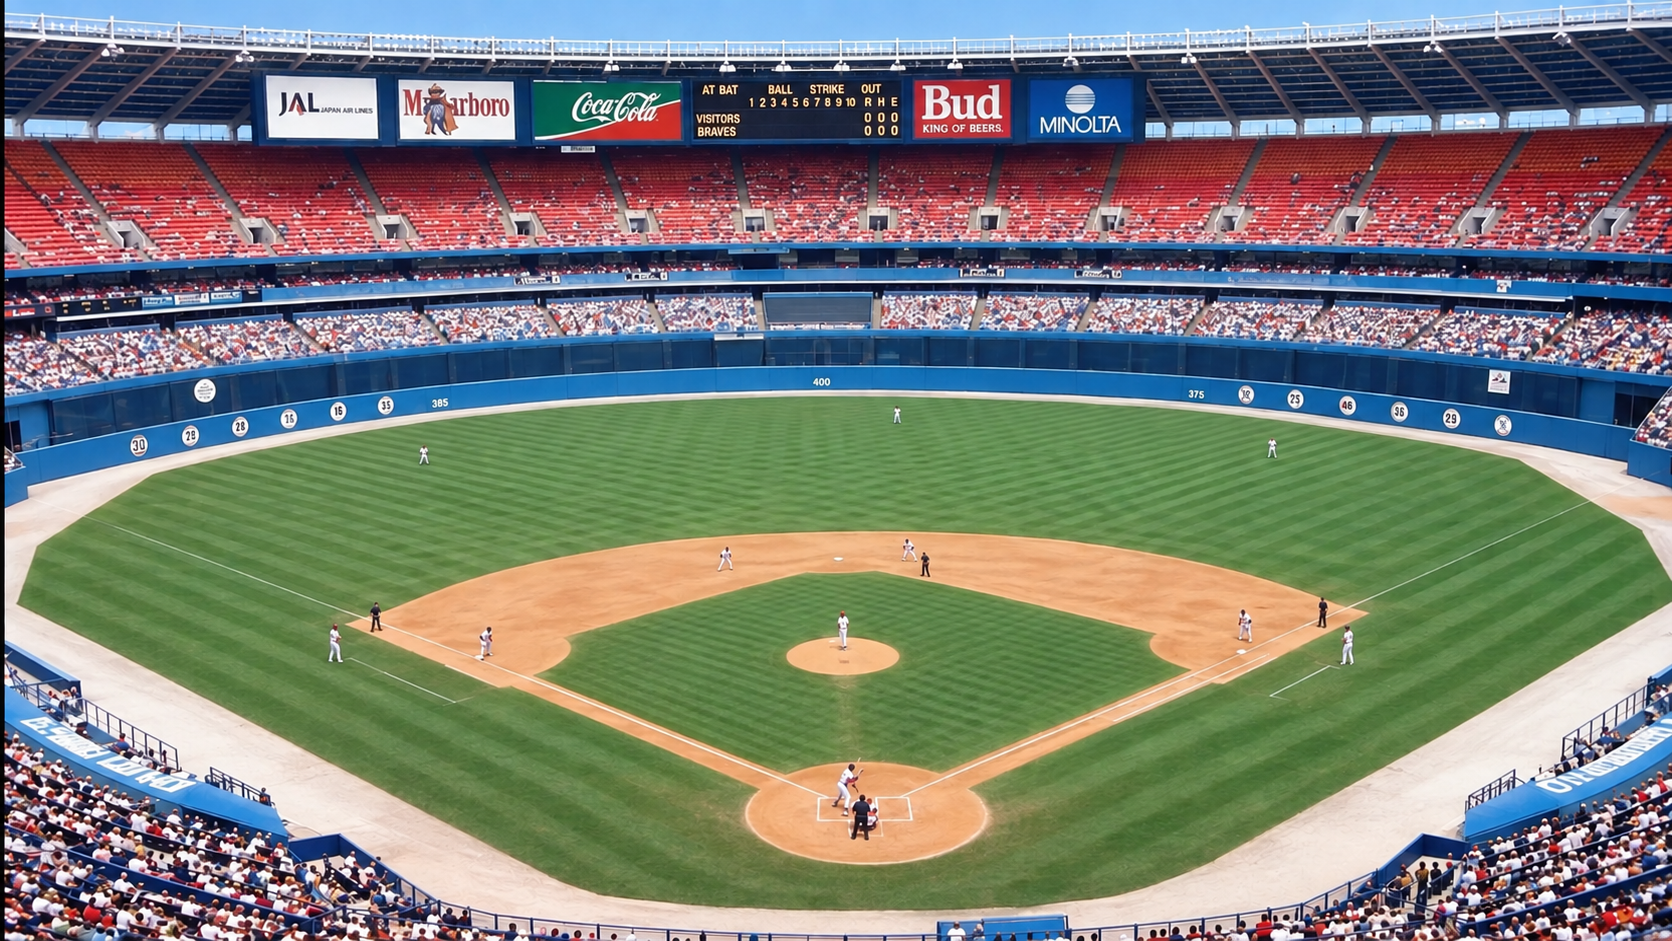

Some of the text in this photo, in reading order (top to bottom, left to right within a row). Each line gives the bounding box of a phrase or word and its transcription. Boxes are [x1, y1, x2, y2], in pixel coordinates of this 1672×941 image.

[702, 84, 882, 94] AT BAT BALL STRIKE OUT
[279, 92, 319, 116] JAL
[572, 92, 661, 122] Coca-Cola
[749, 97, 898, 107] 1 2 3 4 5 6 7 8 9 10 R H E
[922, 84, 1003, 120] Bud
[696, 112, 898, 123] VISITORS 0 0 0
[697, 125, 898, 136] BRAVES 0 0 0
[922, 124, 1004, 133] KING OF BEERS.
[1040, 116, 1121, 134] MINOLTA
[812, 378, 831, 387] 400
[1188, 389, 1205, 399] 375
[1290, 393, 1300, 404] 25
[432, 398, 449, 408] 385
[1445, 412, 1457, 424] 29
[132, 438, 145, 452] 30
